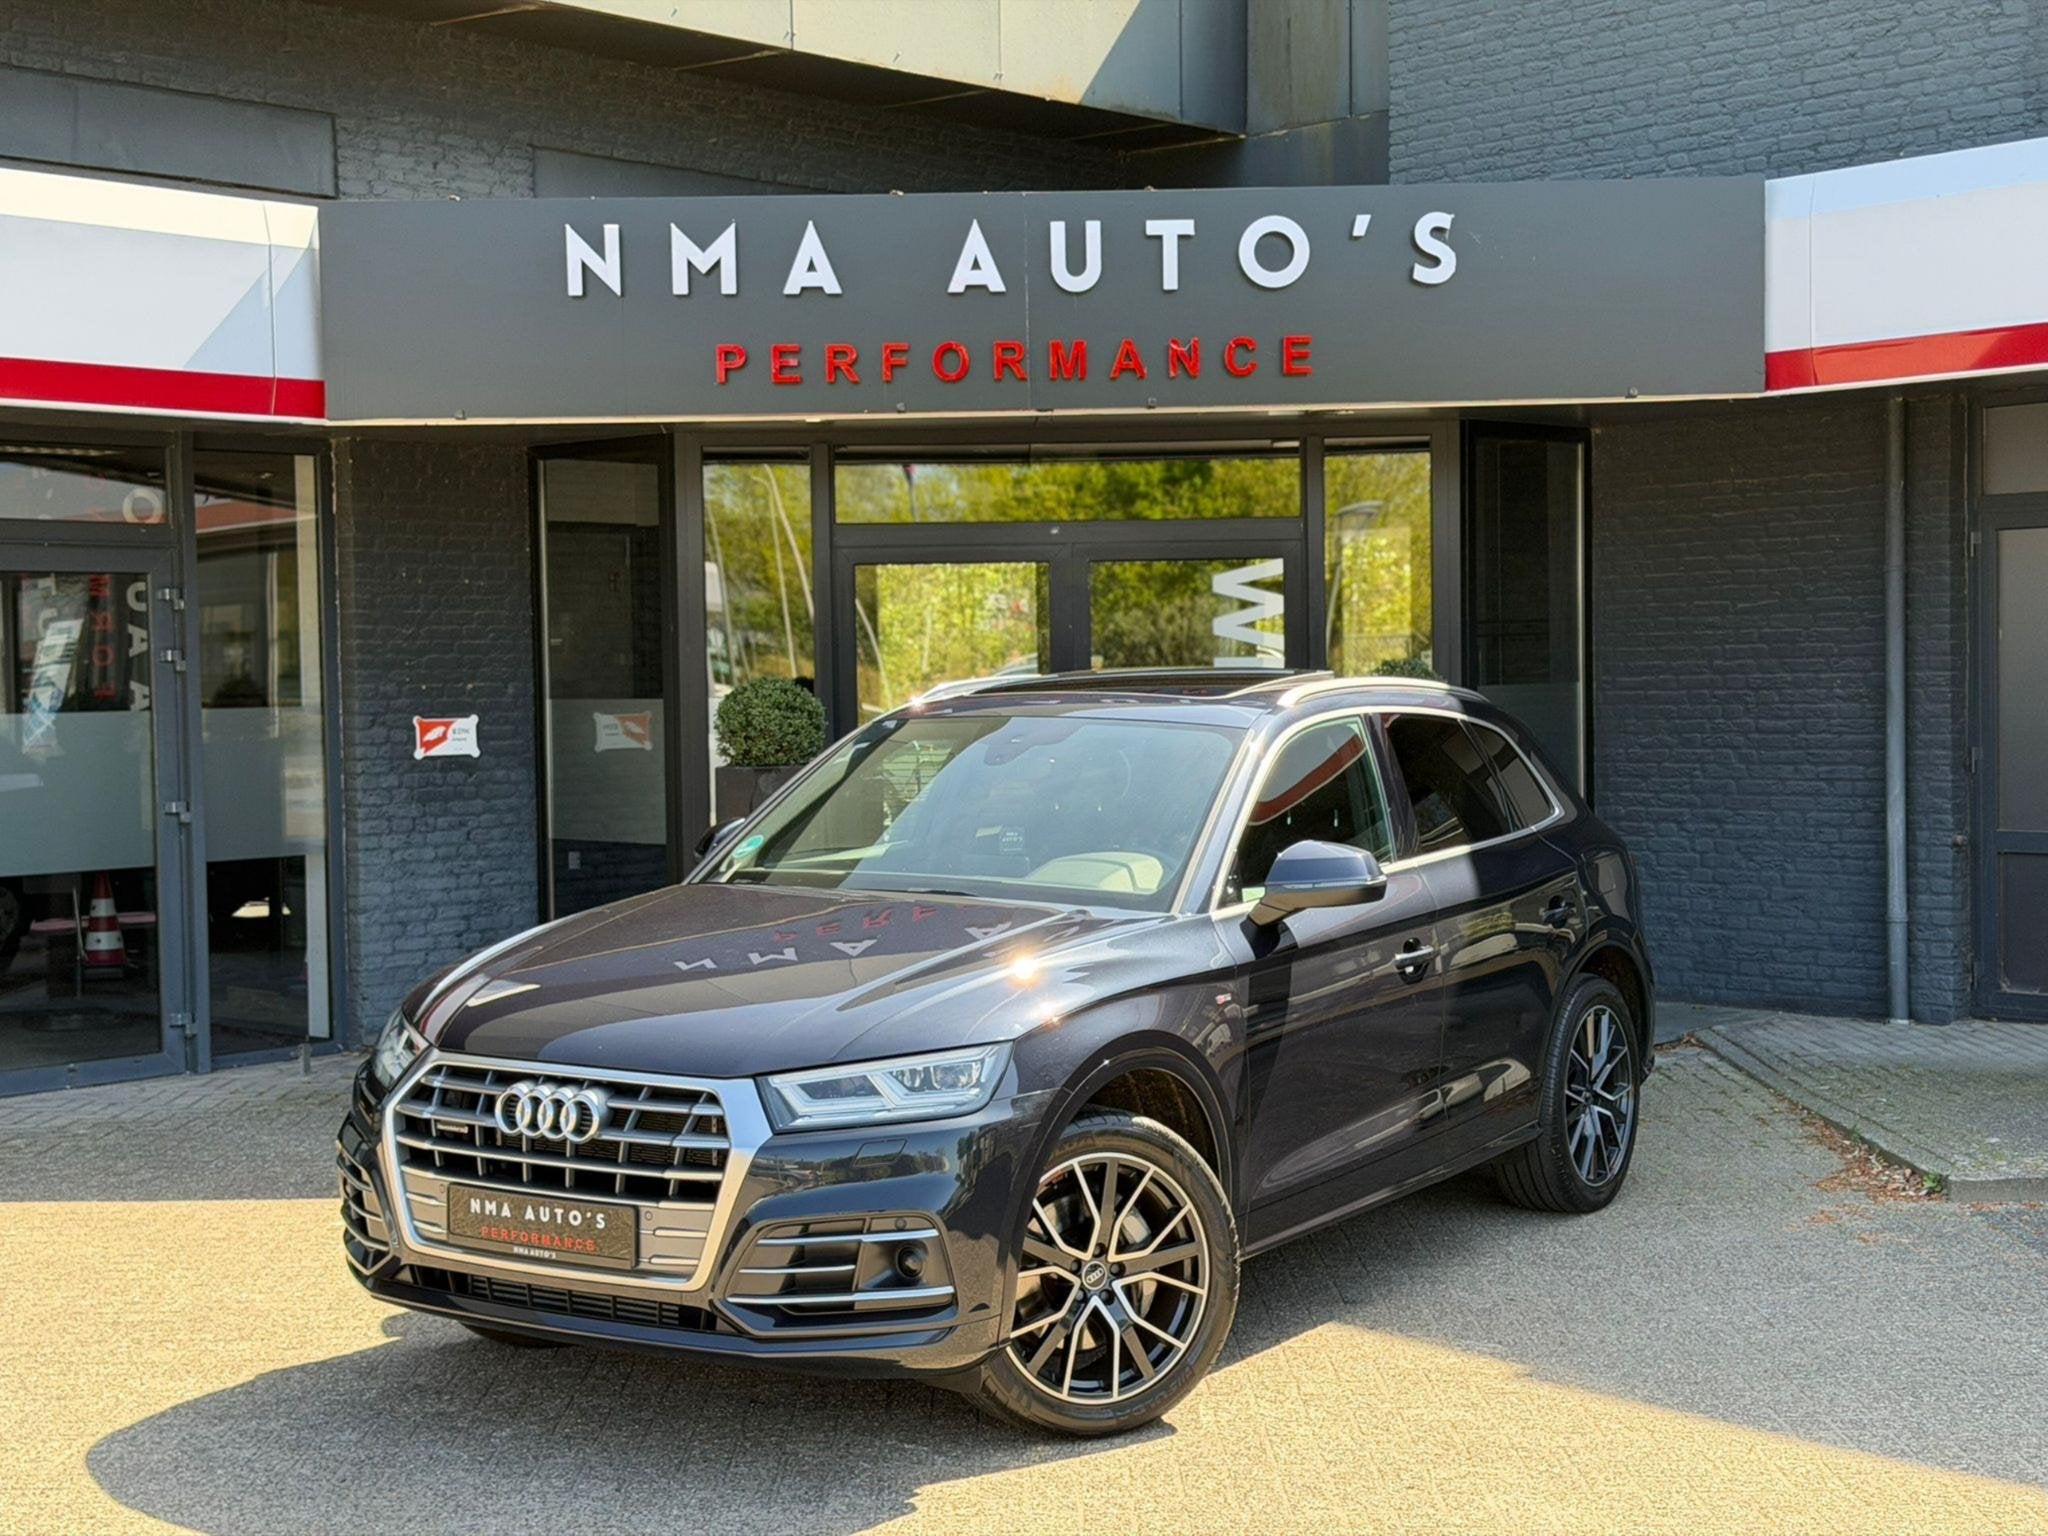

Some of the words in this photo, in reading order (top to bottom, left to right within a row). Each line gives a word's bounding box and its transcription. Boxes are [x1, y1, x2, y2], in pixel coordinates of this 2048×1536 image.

[564, 219, 844, 299] NMA
[946, 211, 1458, 295] AUTO'S
[715, 334, 1315, 385] PERFORMANCE
[470, 1198, 512, 1218] NMA
[524, 1205, 606, 1230] AUTO'S
[481, 1227, 596, 1251] PERFORMANCE
